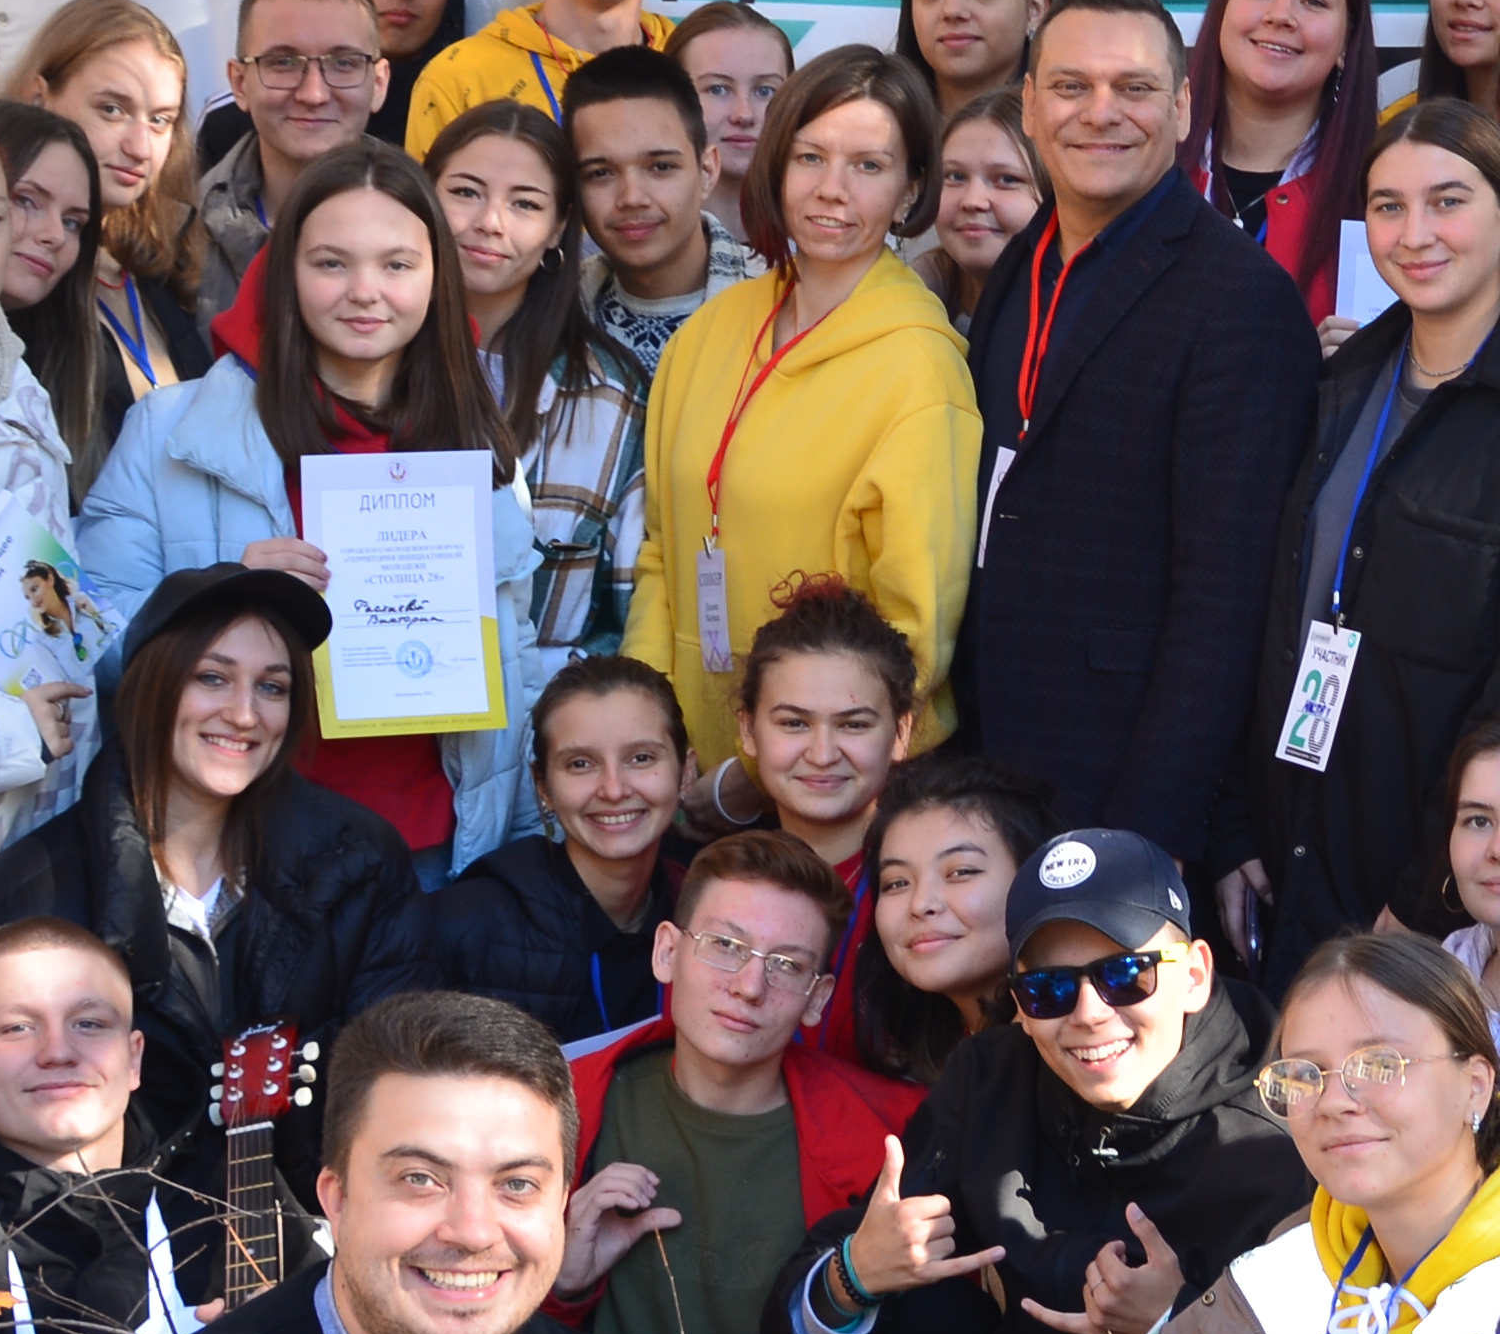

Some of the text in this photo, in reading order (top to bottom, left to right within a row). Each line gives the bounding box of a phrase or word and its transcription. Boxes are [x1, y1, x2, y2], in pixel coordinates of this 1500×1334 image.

[359, 493, 436, 513] ДИПЛОМ
[376, 530, 428, 542] ЛИДЕРА
[363, 573, 425, 585] «СТОЛИЦА
[1311, 646, 1349, 668] УЧАСТНИК
[1045, 857, 1087, 873] NEW ERA
